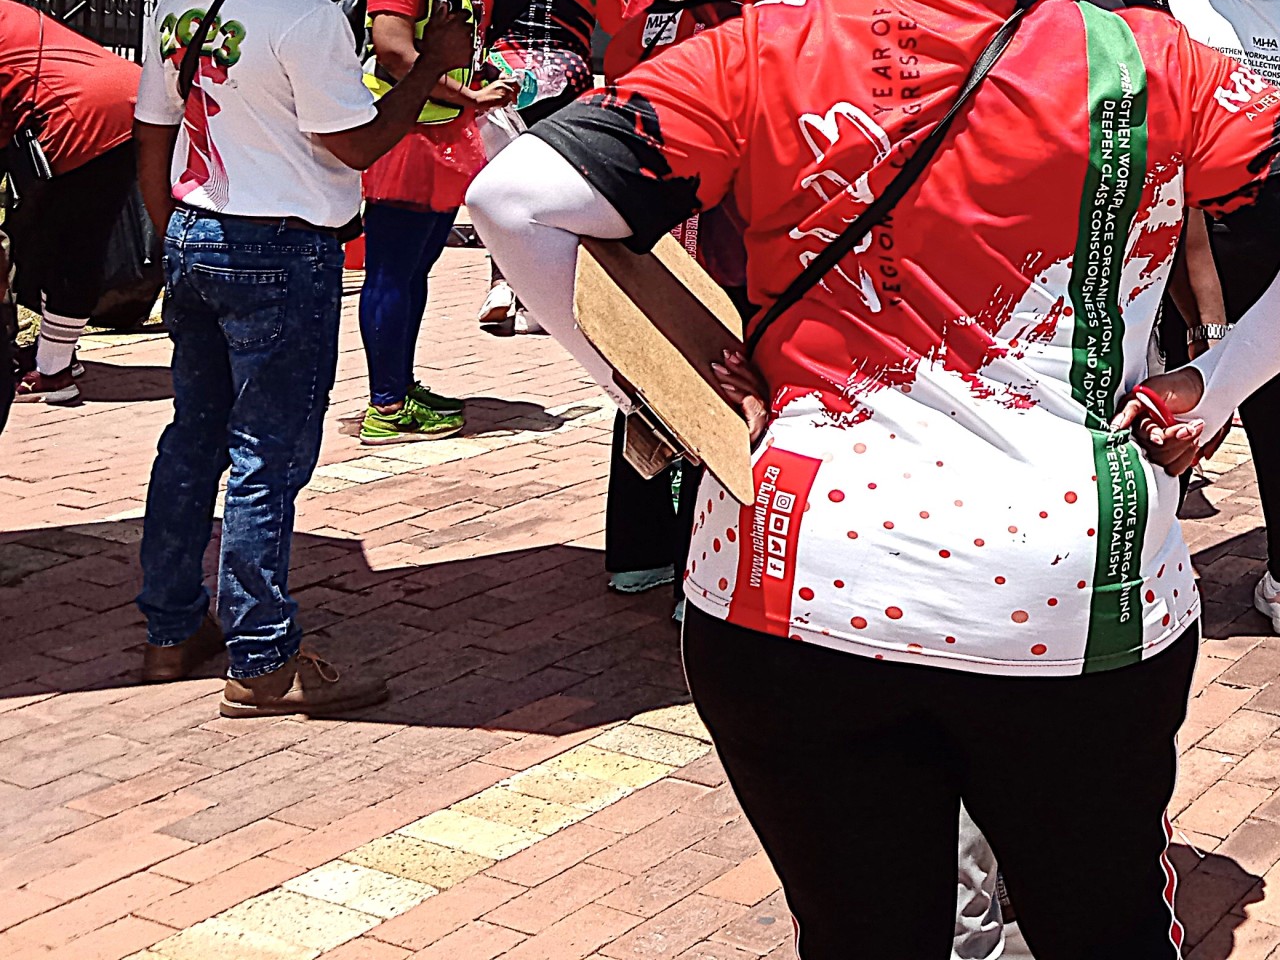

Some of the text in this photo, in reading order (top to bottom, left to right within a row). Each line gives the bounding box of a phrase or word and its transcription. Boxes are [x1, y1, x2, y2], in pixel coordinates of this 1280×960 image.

[871, 8, 893, 116] YEAR OF
[1252, 37, 1279, 48] MHA
[1101, 100, 1116, 160] DEEPEN
[1118, 62, 1134, 149] STRENGTHEN
[1245, 111, 1258, 121] A
[1253, 95, 1279, 113] LIFE
[1094, 163, 1113, 206] CLASS
[1103, 152, 1131, 241] WORKPLACE
[1082, 210, 1102, 328] CONSCIOUSNESS
[1087, 335, 1098, 369] AND
[1100, 366, 1112, 387] TO
[1116, 434, 1138, 526] COLLECTIVE
[750, 466, 781, 588] www.nehawu.org.za
[1119, 530, 1135, 624] BARGAINING
